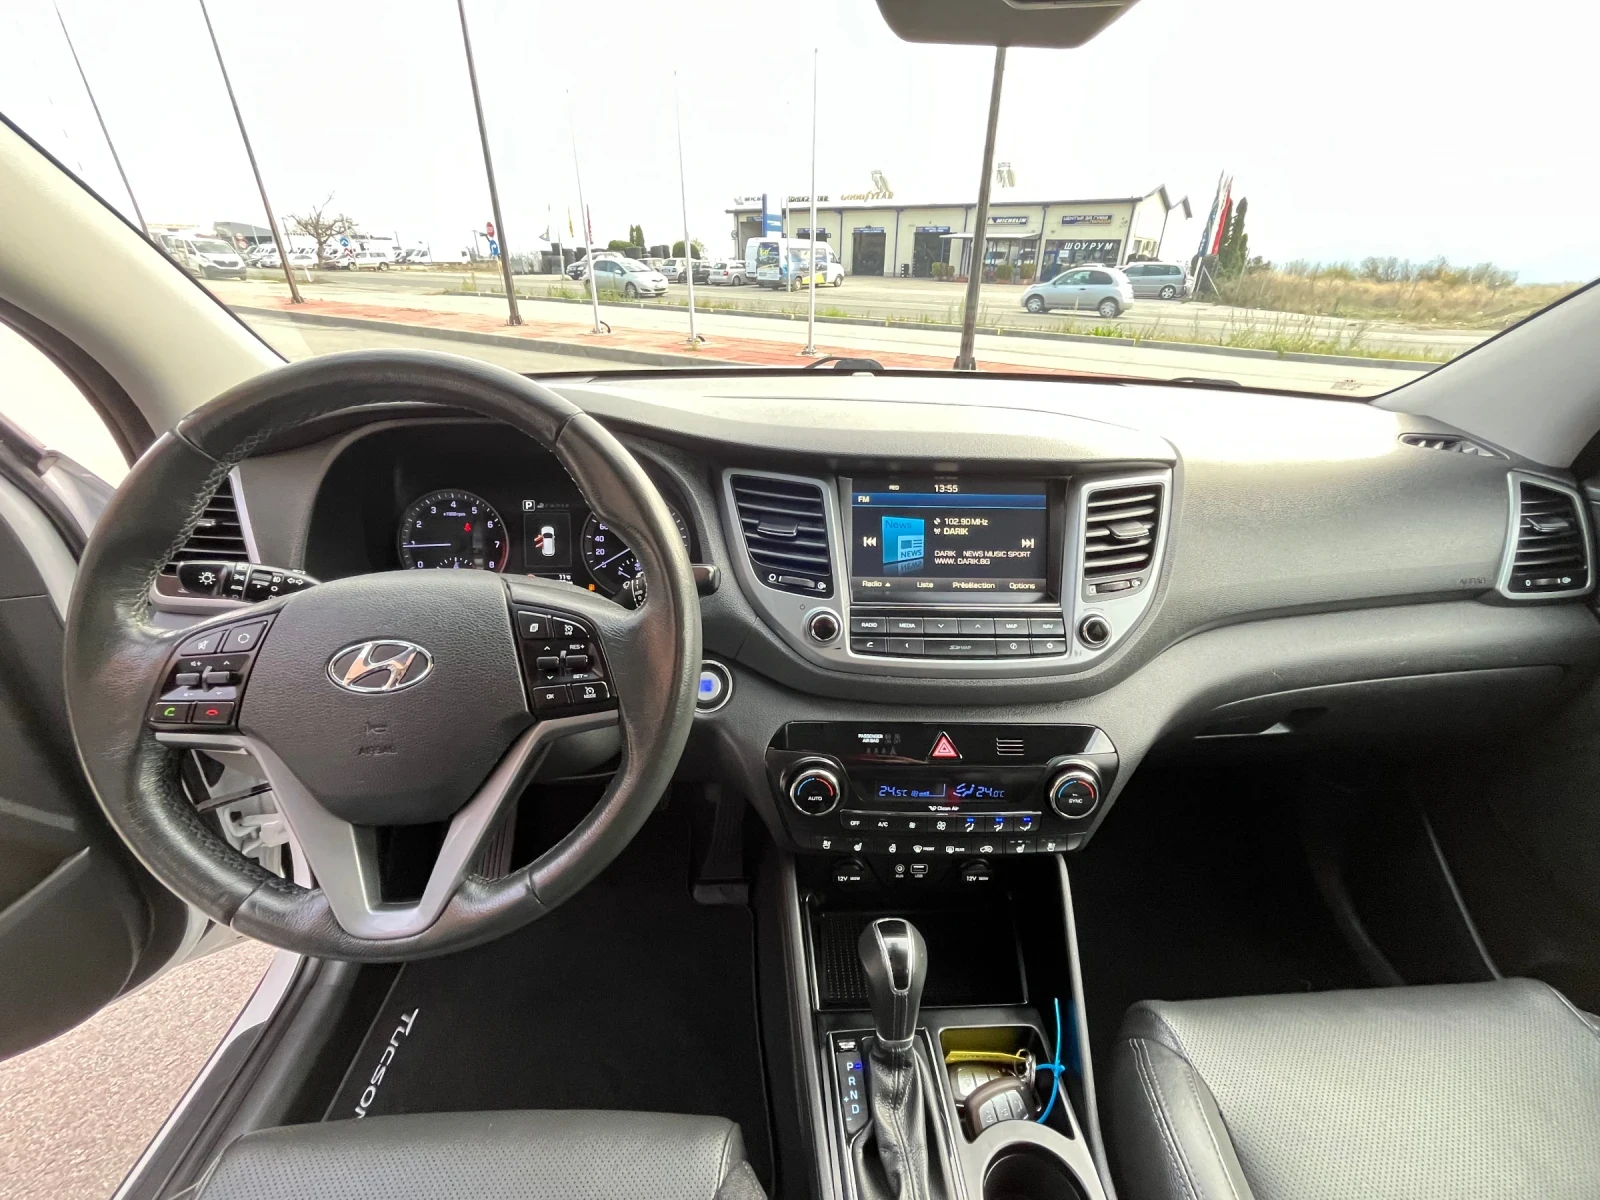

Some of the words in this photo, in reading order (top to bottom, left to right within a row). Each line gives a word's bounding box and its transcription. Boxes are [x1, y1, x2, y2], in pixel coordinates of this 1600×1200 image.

[934, 484, 959, 493] 13:55
[857, 495, 870, 503] FM
[525, 501, 533, 510] P
[487, 521, 494, 529] 6
[885, 519, 912, 529] News
[971, 518, 989, 526] MHz
[943, 527, 969, 535] DARIK
[594, 535, 605, 543] 40
[494, 541, 500, 549] 7
[900, 549, 923, 559] NEWS
[984, 550, 1007, 558] MUSIC
[1007, 550, 1032, 558] SPORT
[952, 581, 996, 589] Présélection
[1009, 582, 1036, 590] Options
[846, 1062, 854, 1072] P
[847, 1076, 856, 1086] R
[849, 1090, 858, 1100] N
[851, 1104, 860, 1114] D
